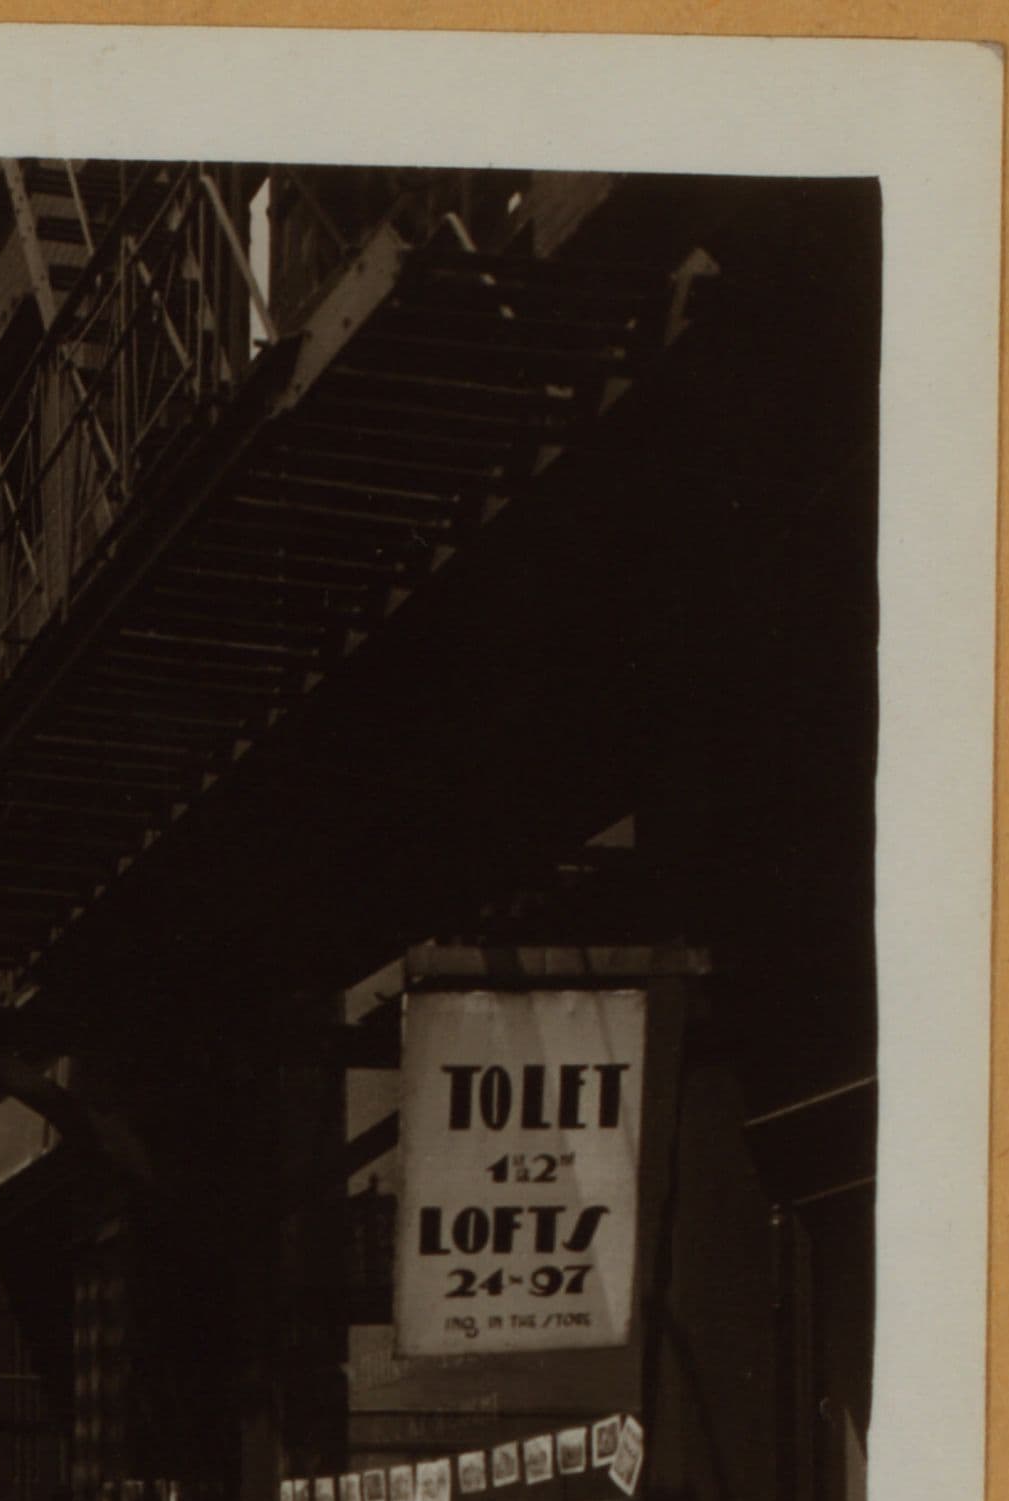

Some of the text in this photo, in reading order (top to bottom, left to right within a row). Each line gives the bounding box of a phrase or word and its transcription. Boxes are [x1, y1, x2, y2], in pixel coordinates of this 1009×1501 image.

[440, 1063, 631, 1131] TO LET
[418, 1205, 611, 1256] LOFTS
[487, 1315, 503, 1328] IN
[510, 1313, 537, 1328] THE
